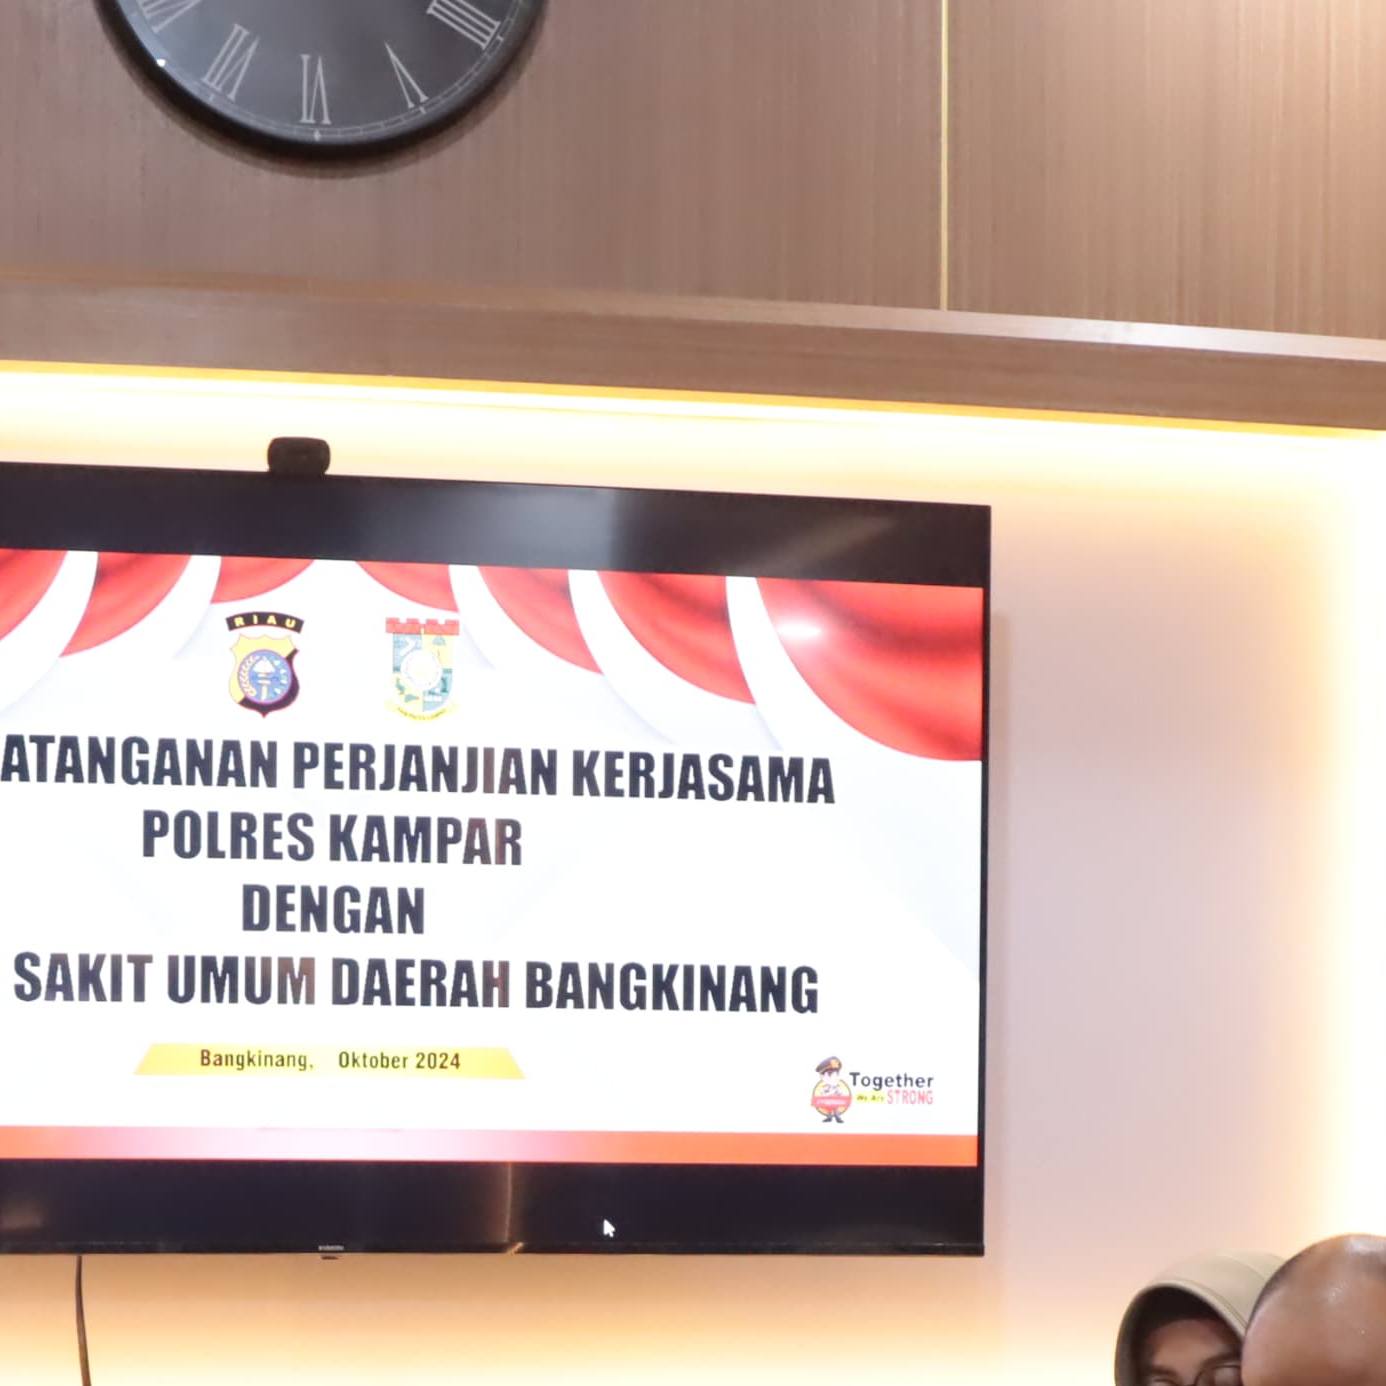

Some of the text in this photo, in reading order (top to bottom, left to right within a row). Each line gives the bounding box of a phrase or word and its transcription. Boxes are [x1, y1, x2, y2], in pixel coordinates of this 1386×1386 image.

[234, 613, 297, 630] RIAU
[293, 741, 558, 796] PERJANJIAN
[572, 749, 836, 804] KERJASAMA
[142, 809, 522, 866] POLRES KAMPAR
[242, 884, 425, 935] DENGAN
[14, 951, 153, 1003] SAKIT
[167, 955, 315, 1005] UMUM
[331, 957, 510, 1008] DAERAH
[525, 961, 818, 1014] BANGKINANG
[200, 1049, 461, 1072] Bangkinang, Oktober 2024
[849, 1072, 934, 1091] Together
[886, 1089, 933, 1105] STRONG
